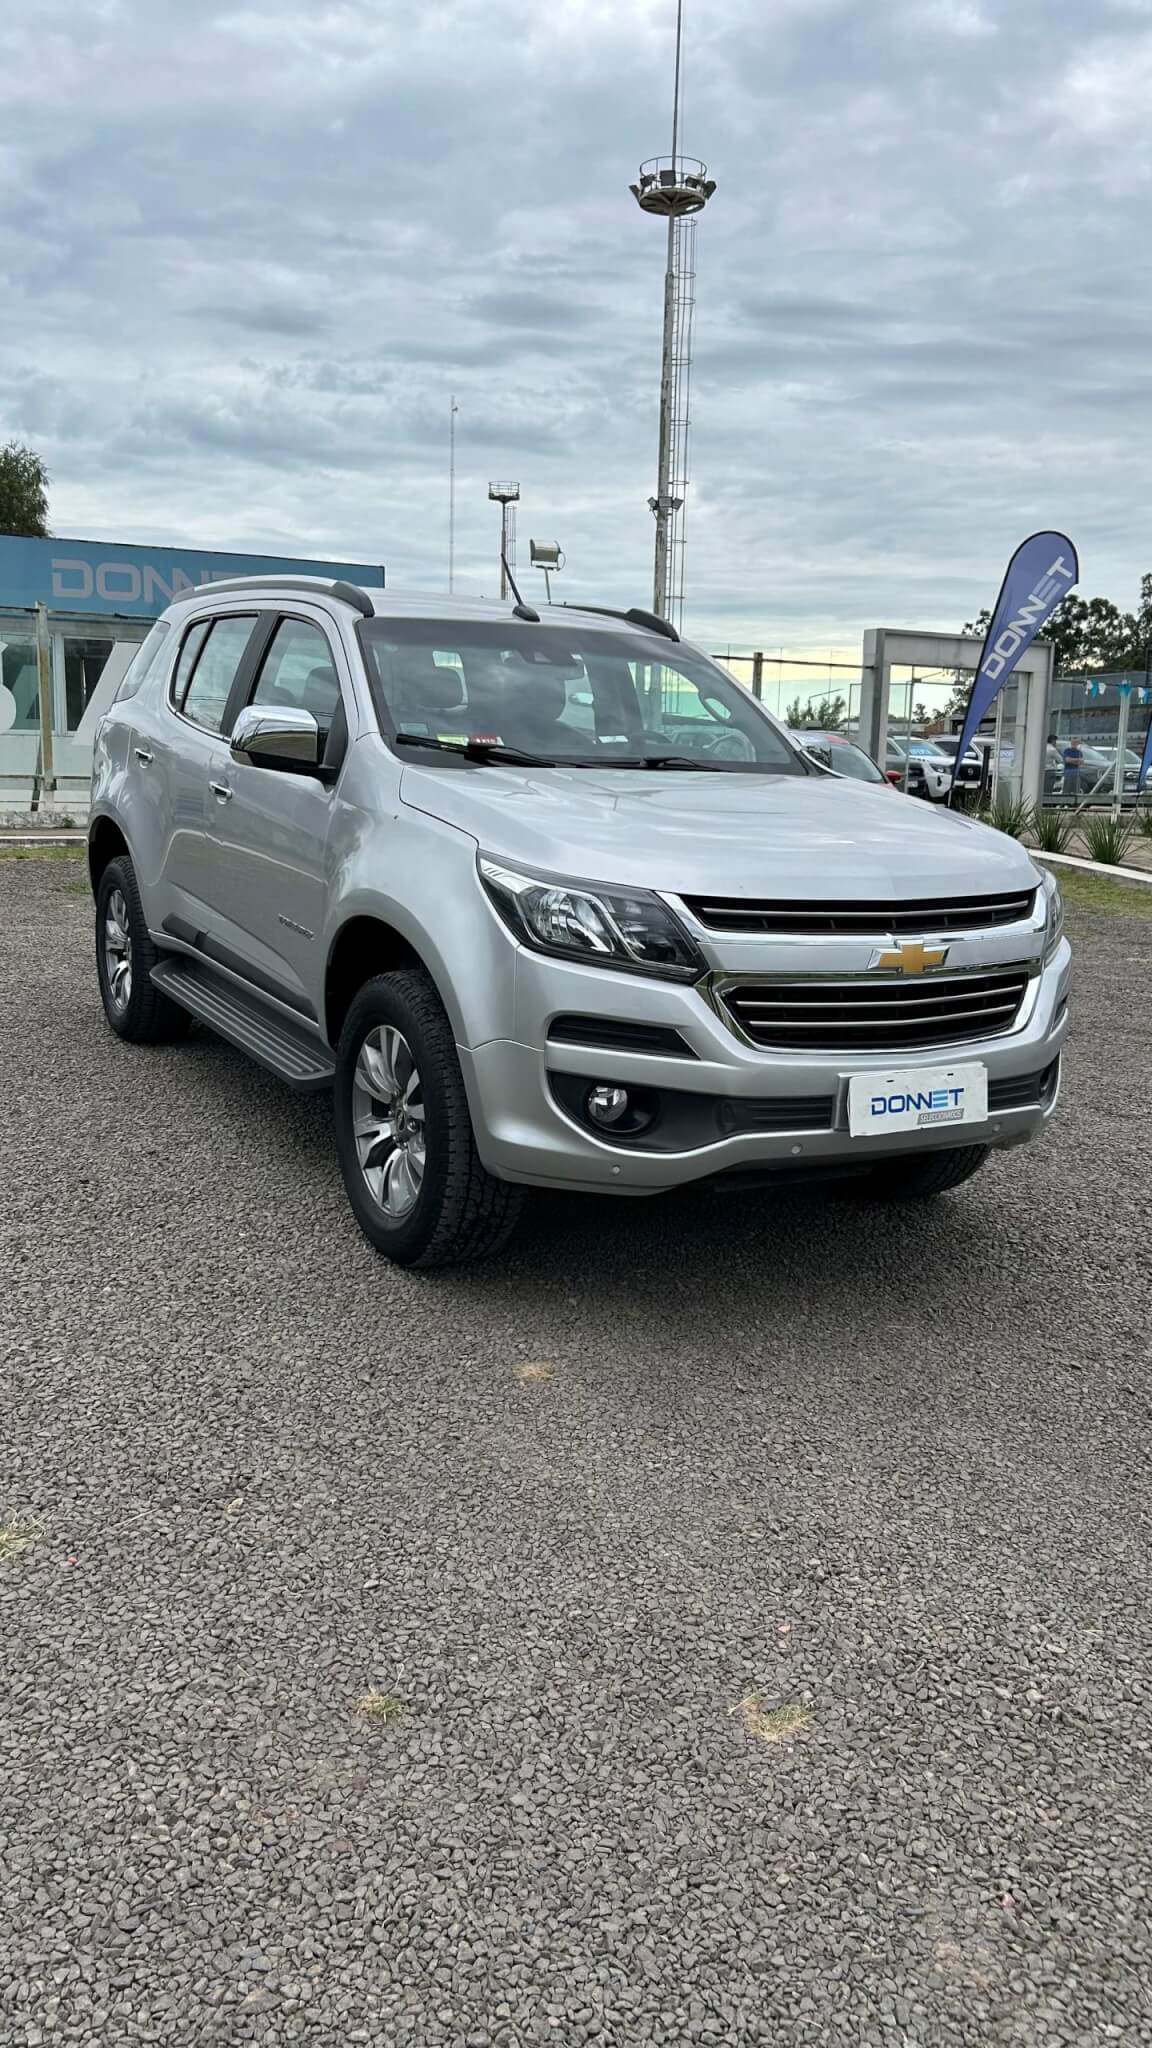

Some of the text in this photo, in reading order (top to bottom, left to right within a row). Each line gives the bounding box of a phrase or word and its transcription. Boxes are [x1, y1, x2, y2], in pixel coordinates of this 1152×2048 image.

[51, 558, 249, 602] DONN
[982, 556, 1072, 680] DONNET
[871, 1088, 964, 1115] DONNET
